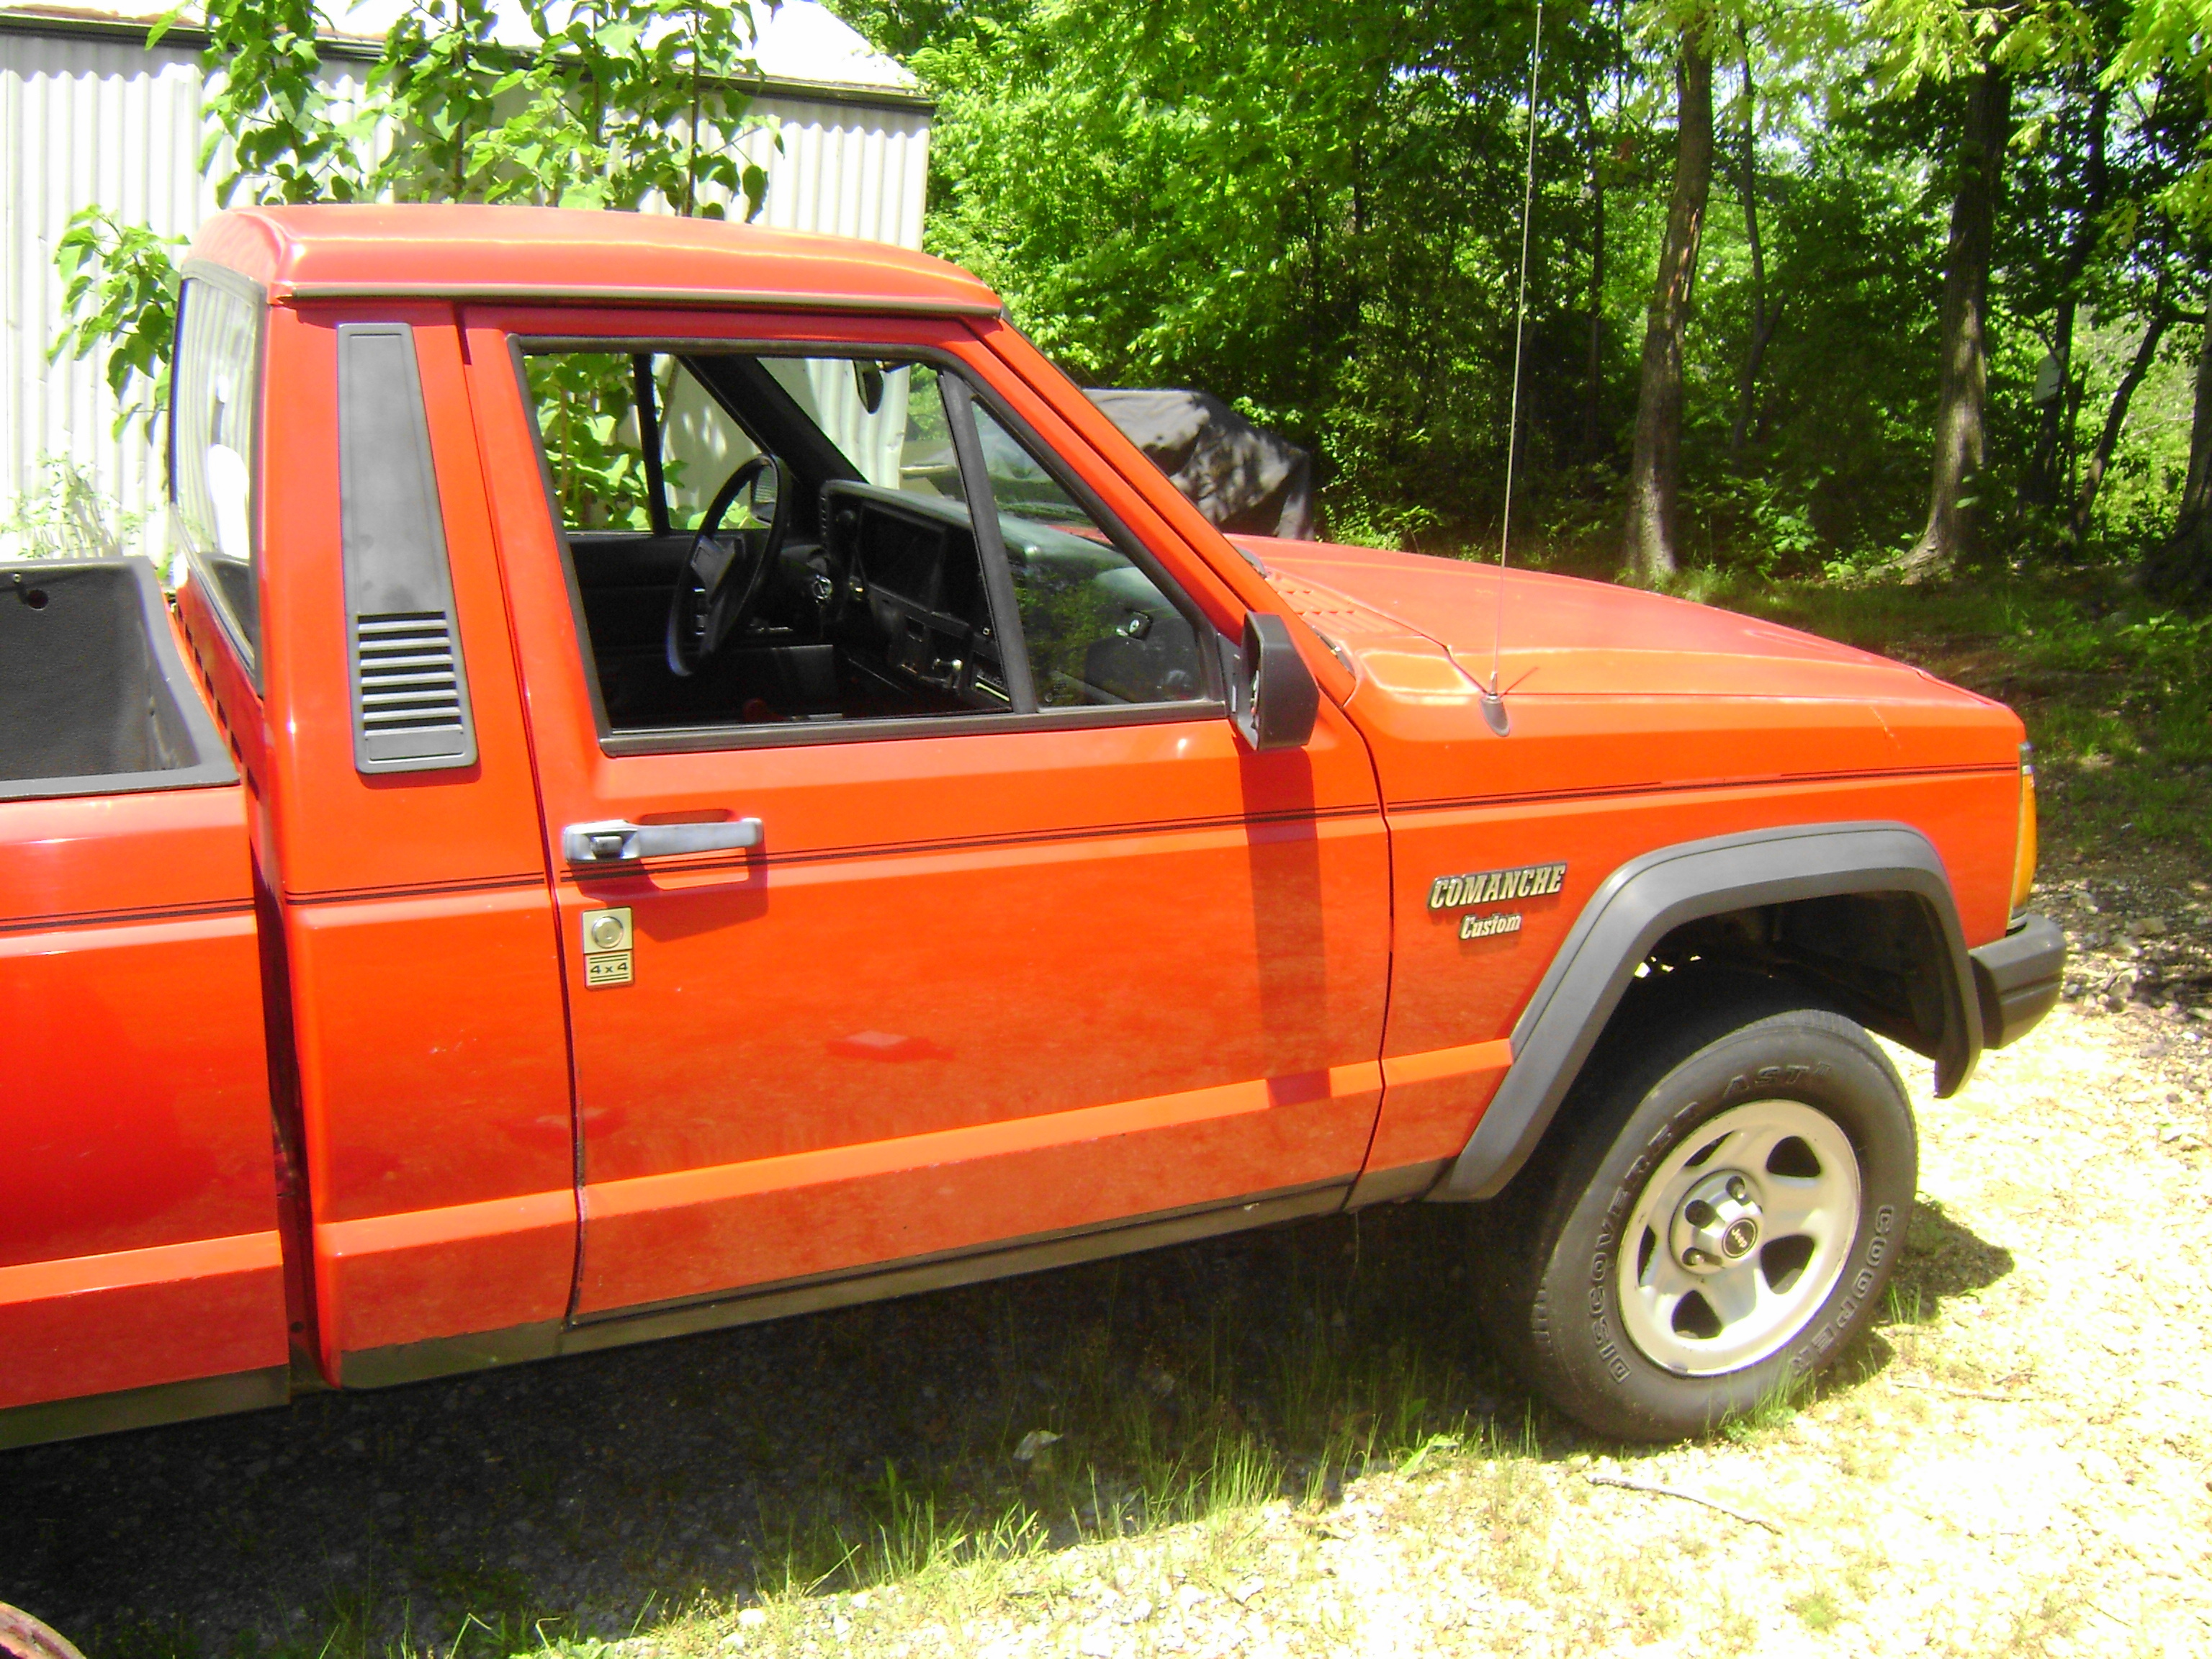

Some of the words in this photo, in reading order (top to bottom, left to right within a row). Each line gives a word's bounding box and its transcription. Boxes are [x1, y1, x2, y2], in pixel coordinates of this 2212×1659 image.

[1429, 863, 1567, 909] COMANCHE
[1460, 913, 1521, 940] Custom
[1731, 1228, 1748, 1248] Jeep
[1789, 1205, 1894, 1376] COOPER
